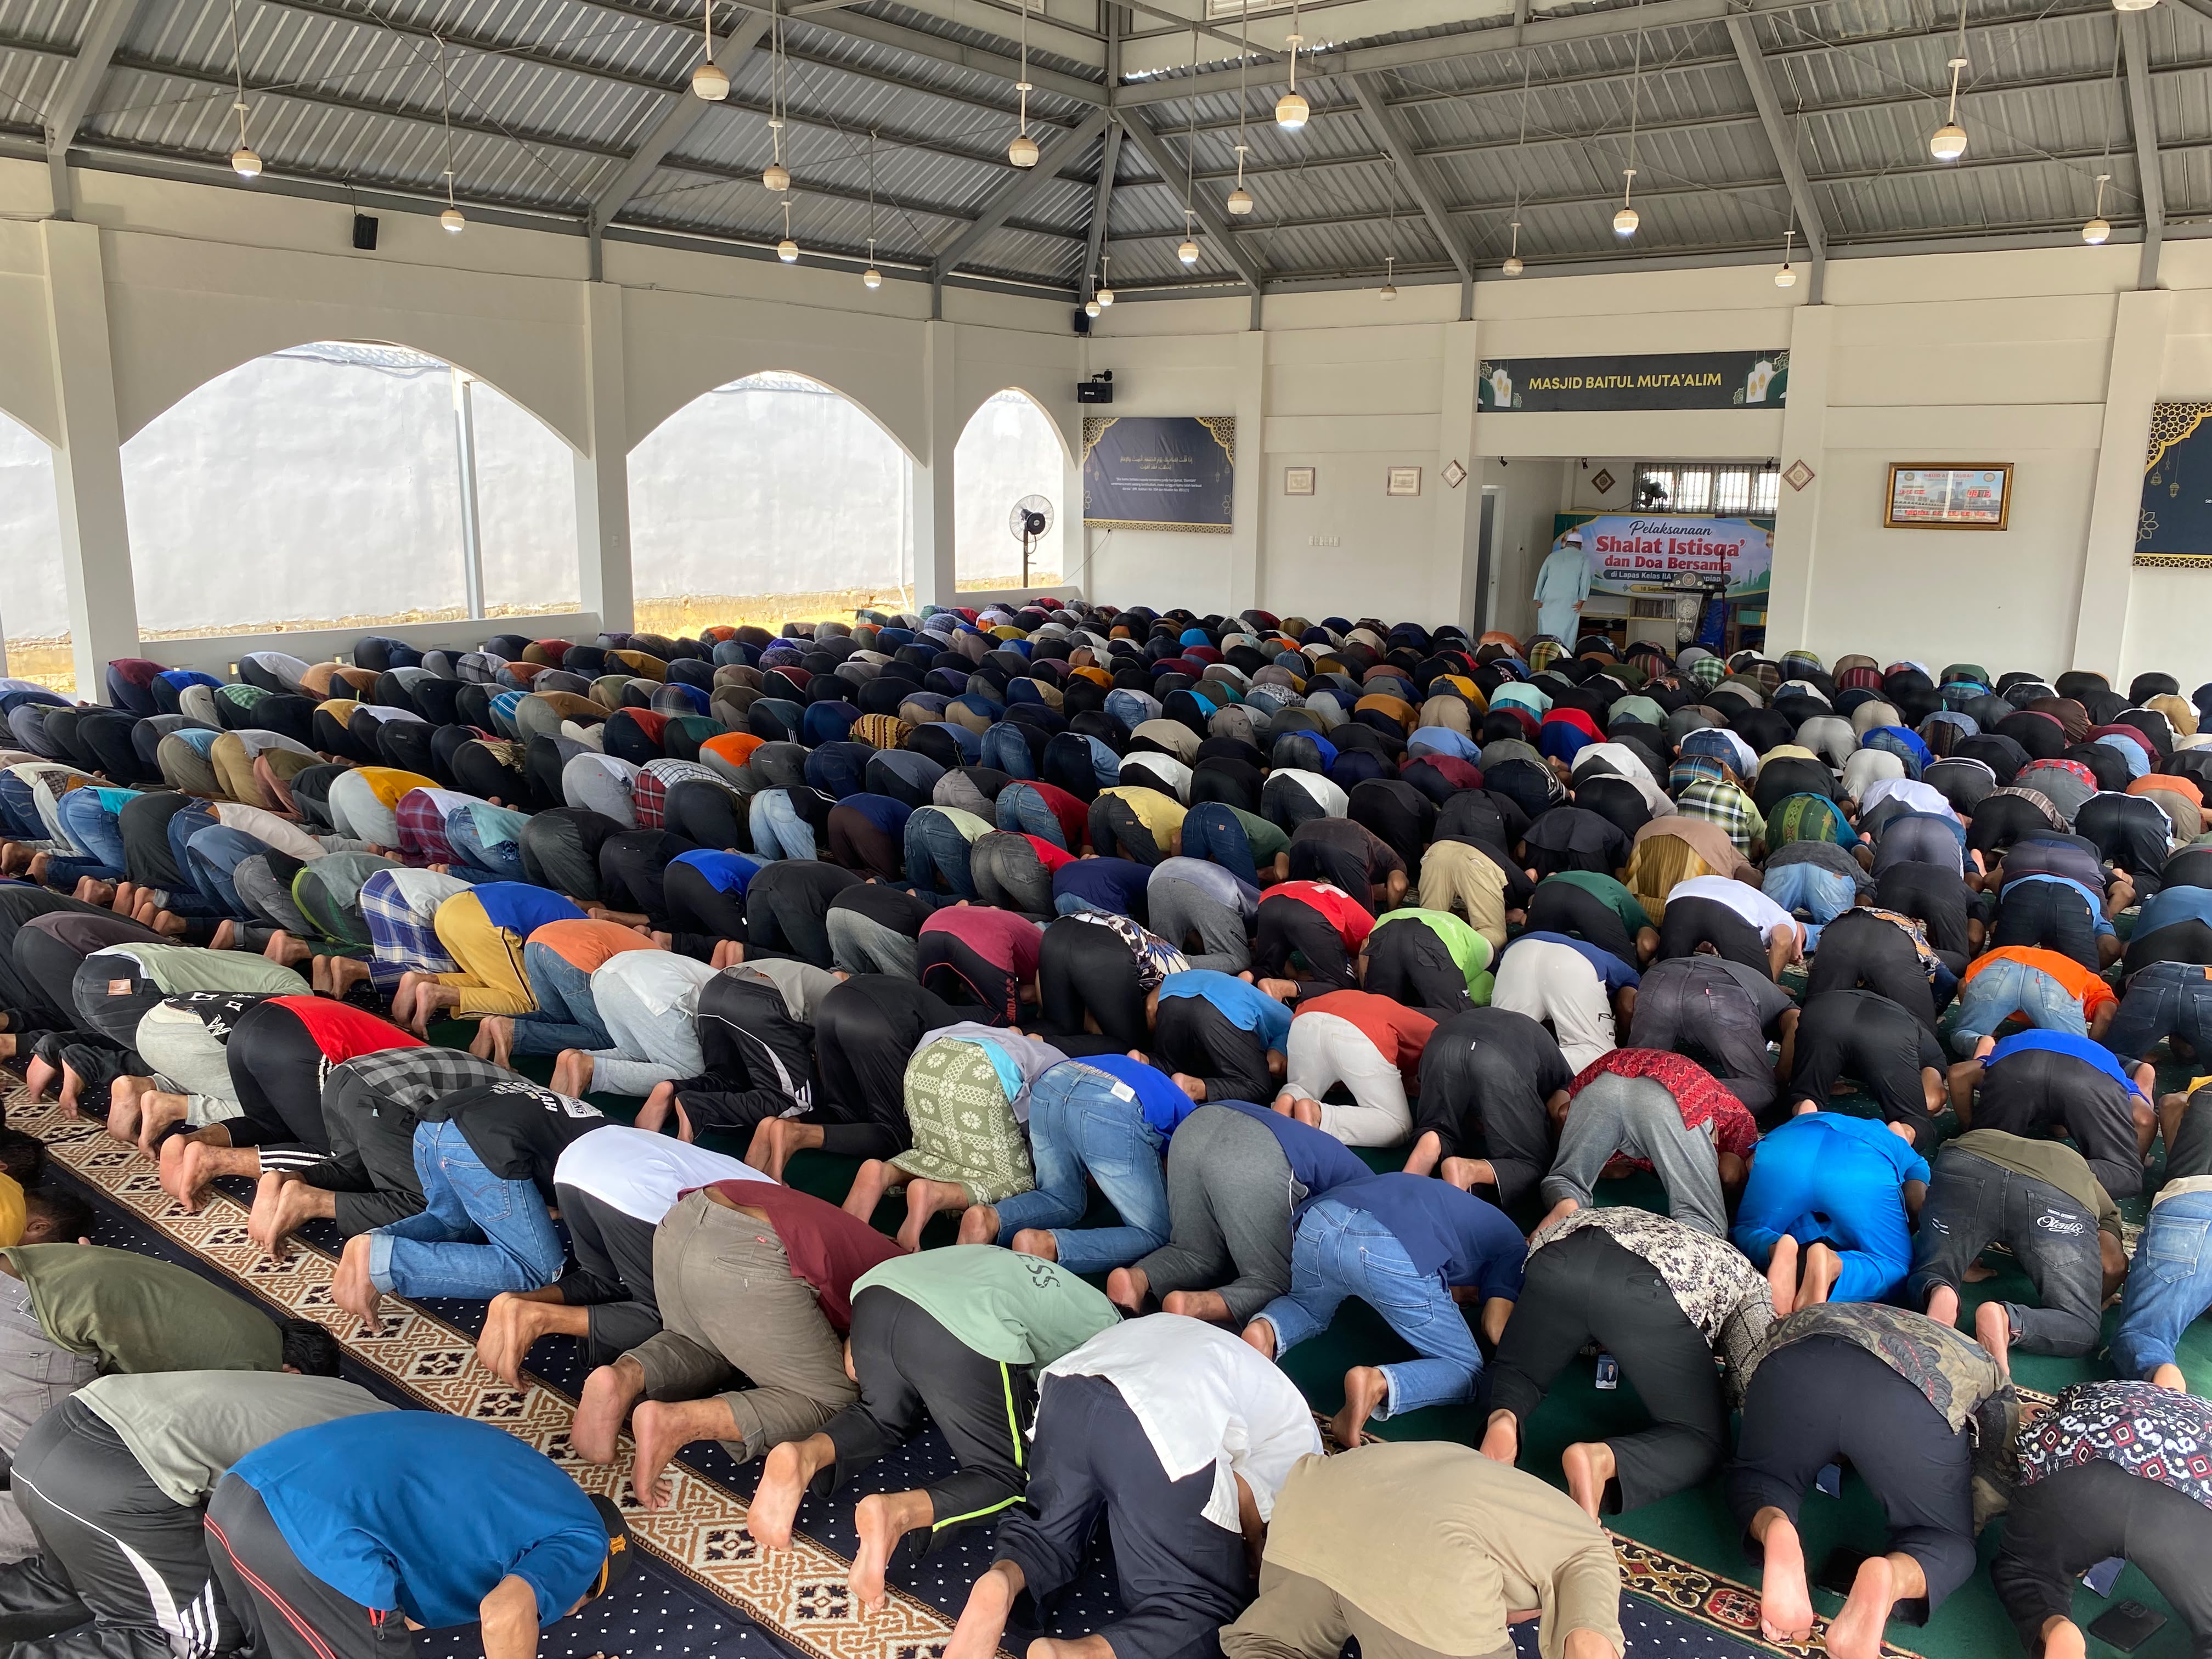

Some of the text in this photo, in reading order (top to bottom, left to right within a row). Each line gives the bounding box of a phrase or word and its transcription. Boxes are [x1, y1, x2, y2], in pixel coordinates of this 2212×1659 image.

[1529, 373, 1722, 390] MASJID BAITUL MUTA'ALIM
[1629, 520, 1712, 536] Pelaksanaan
[1595, 535, 1745, 558] Shalat Istisqa'
[1605, 555, 1731, 571] dan Doa Bersama
[1619, 571, 1639, 579] Lapas
